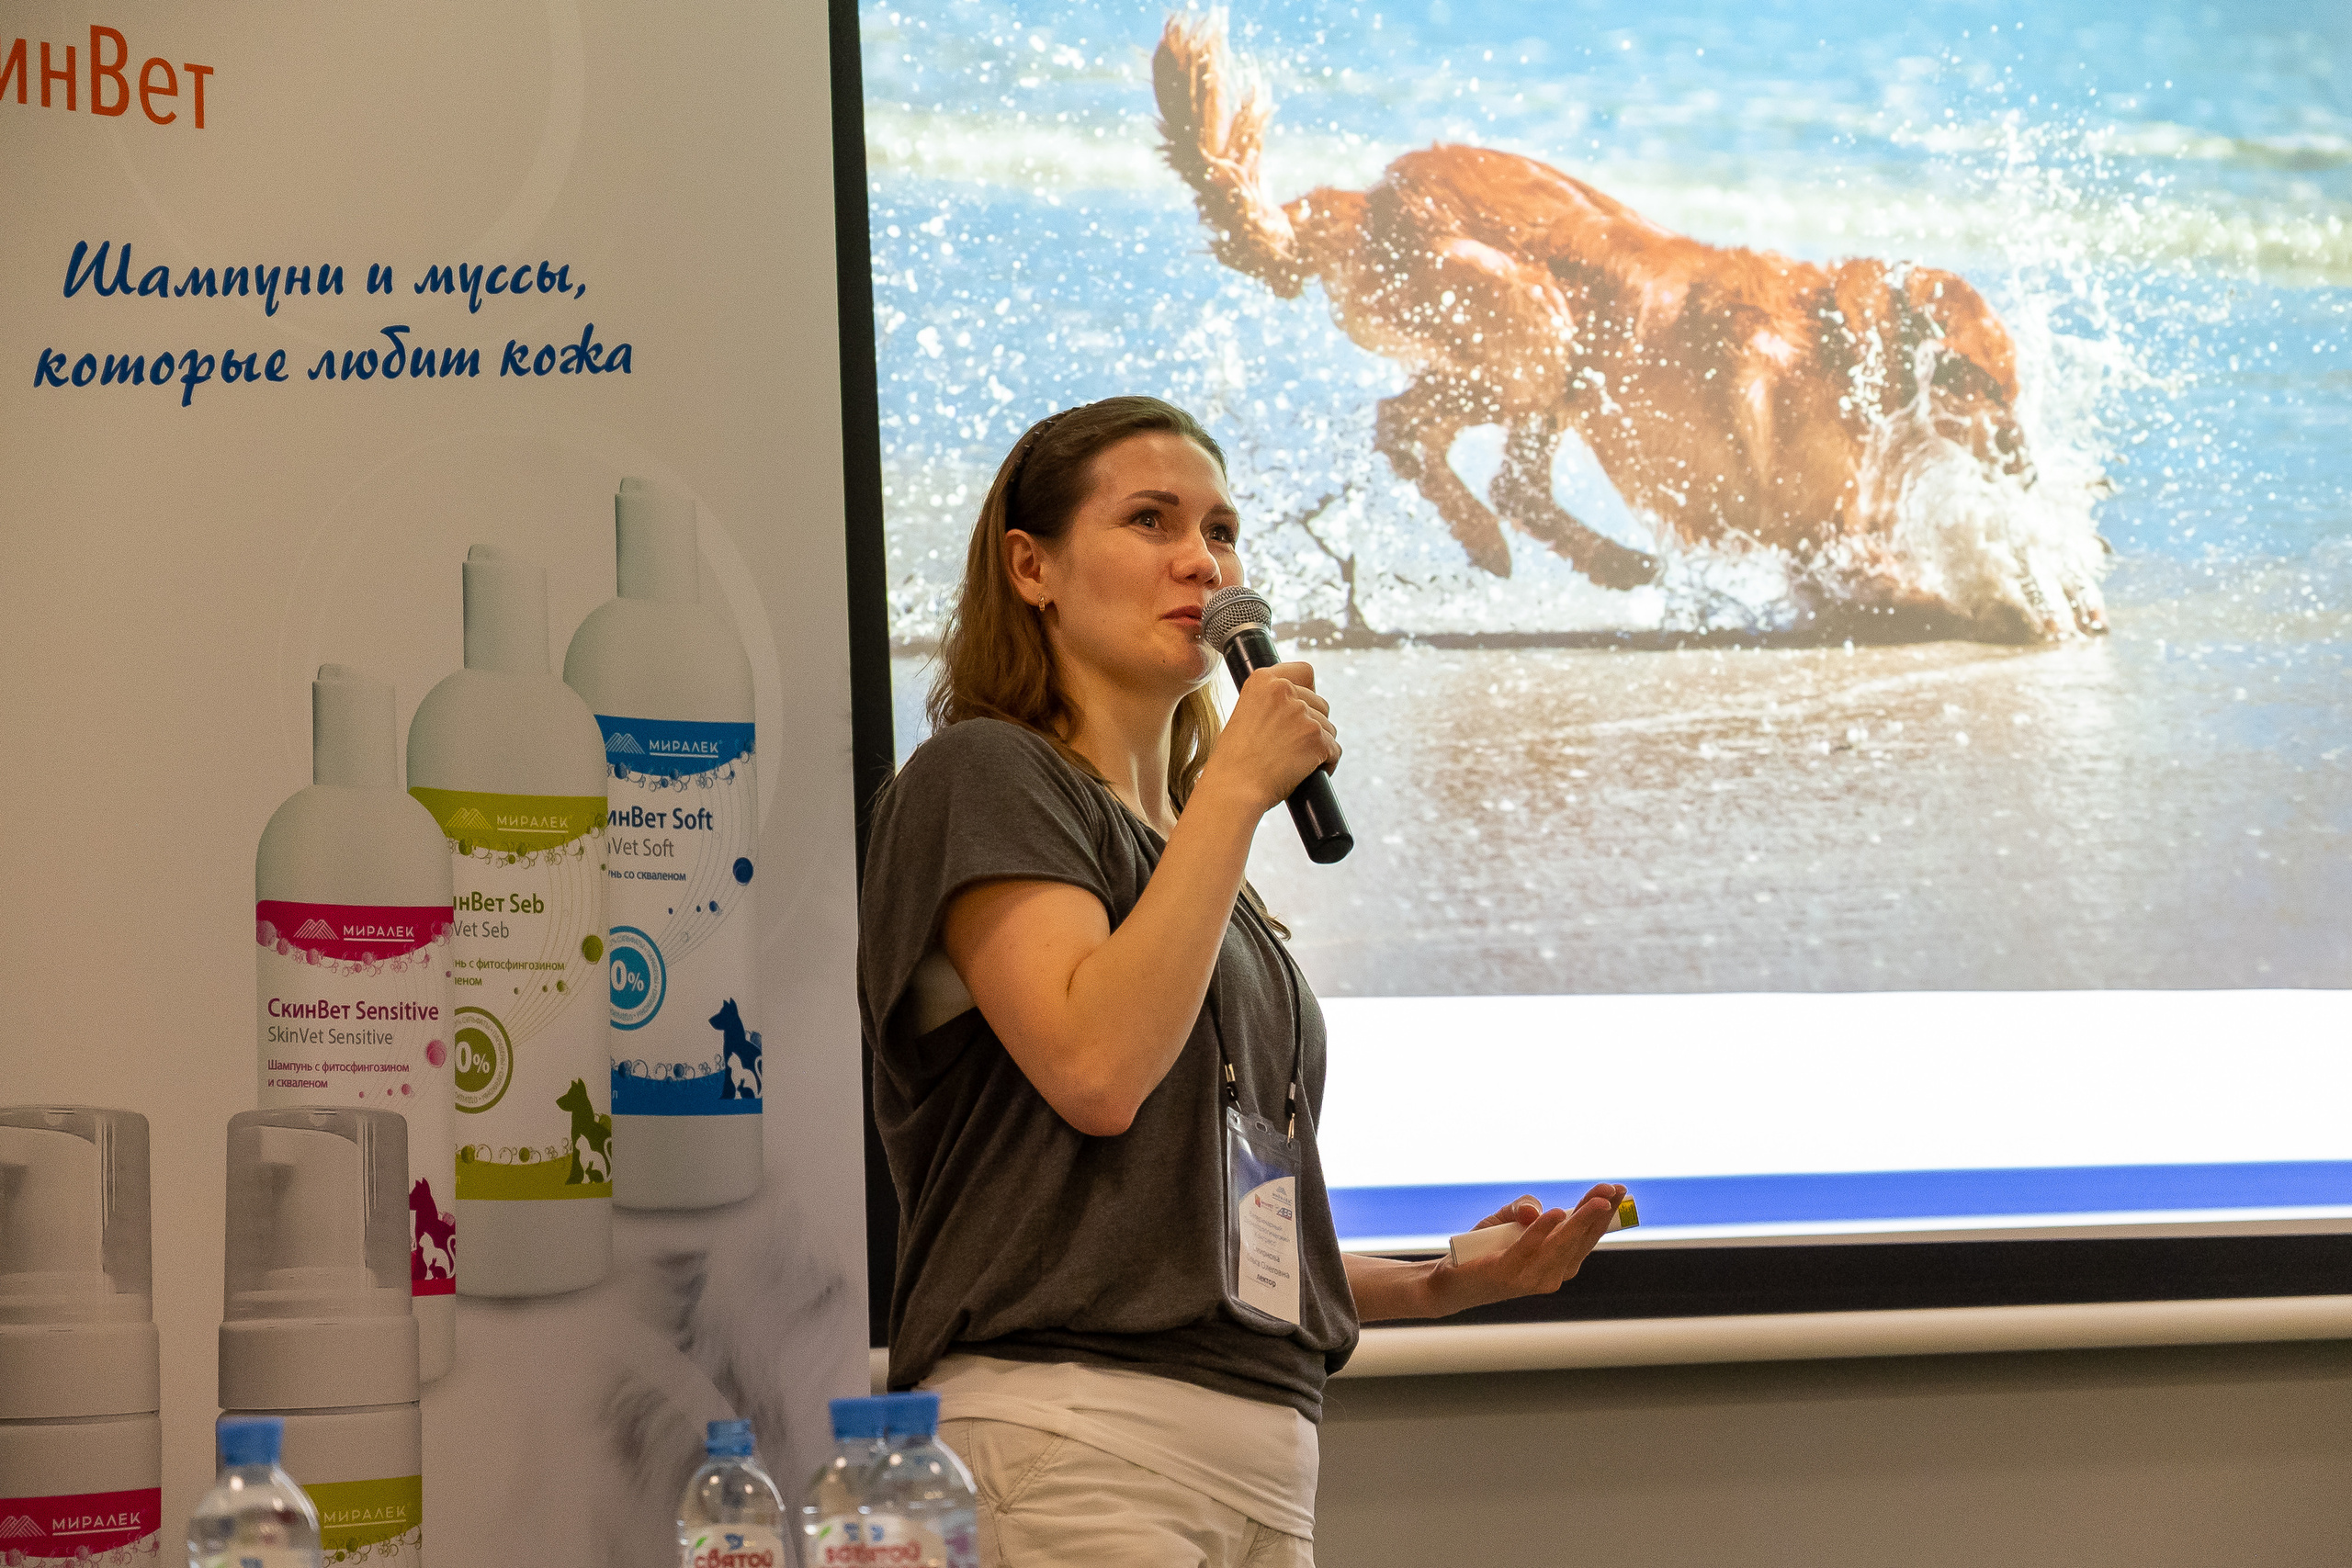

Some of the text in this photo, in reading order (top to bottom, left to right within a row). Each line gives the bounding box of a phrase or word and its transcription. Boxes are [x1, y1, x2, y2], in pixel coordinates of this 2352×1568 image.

[62, 240, 587, 317] Шампуни и муссы,
[33, 322, 633, 407] которые любит кожа
[649, 739, 719, 753] МИРАЛЕК
[497, 815, 568, 828] МИРАЛЕК
[673, 807, 713, 830] Soft
[643, 839, 674, 858] Soft
[637, 872, 686, 882] скваленом
[510, 893, 545, 914] Seb
[343, 925, 414, 938] МИРАЛЕК
[481, 921, 509, 939] Seb
[476, 958, 565, 972] фитосфингозином
[267, 998, 439, 1021] СкинВет Sensitive
[267, 1026, 393, 1045] SkinVet Sensitive
[267, 1059, 410, 1074] Шампунь с фитосфингозином
[267, 1079, 328, 1089] и скваленом
[52, 1512, 141, 1530] МИРАЛЕК
[323, 1505, 406, 1524] МИРАЛЕК
